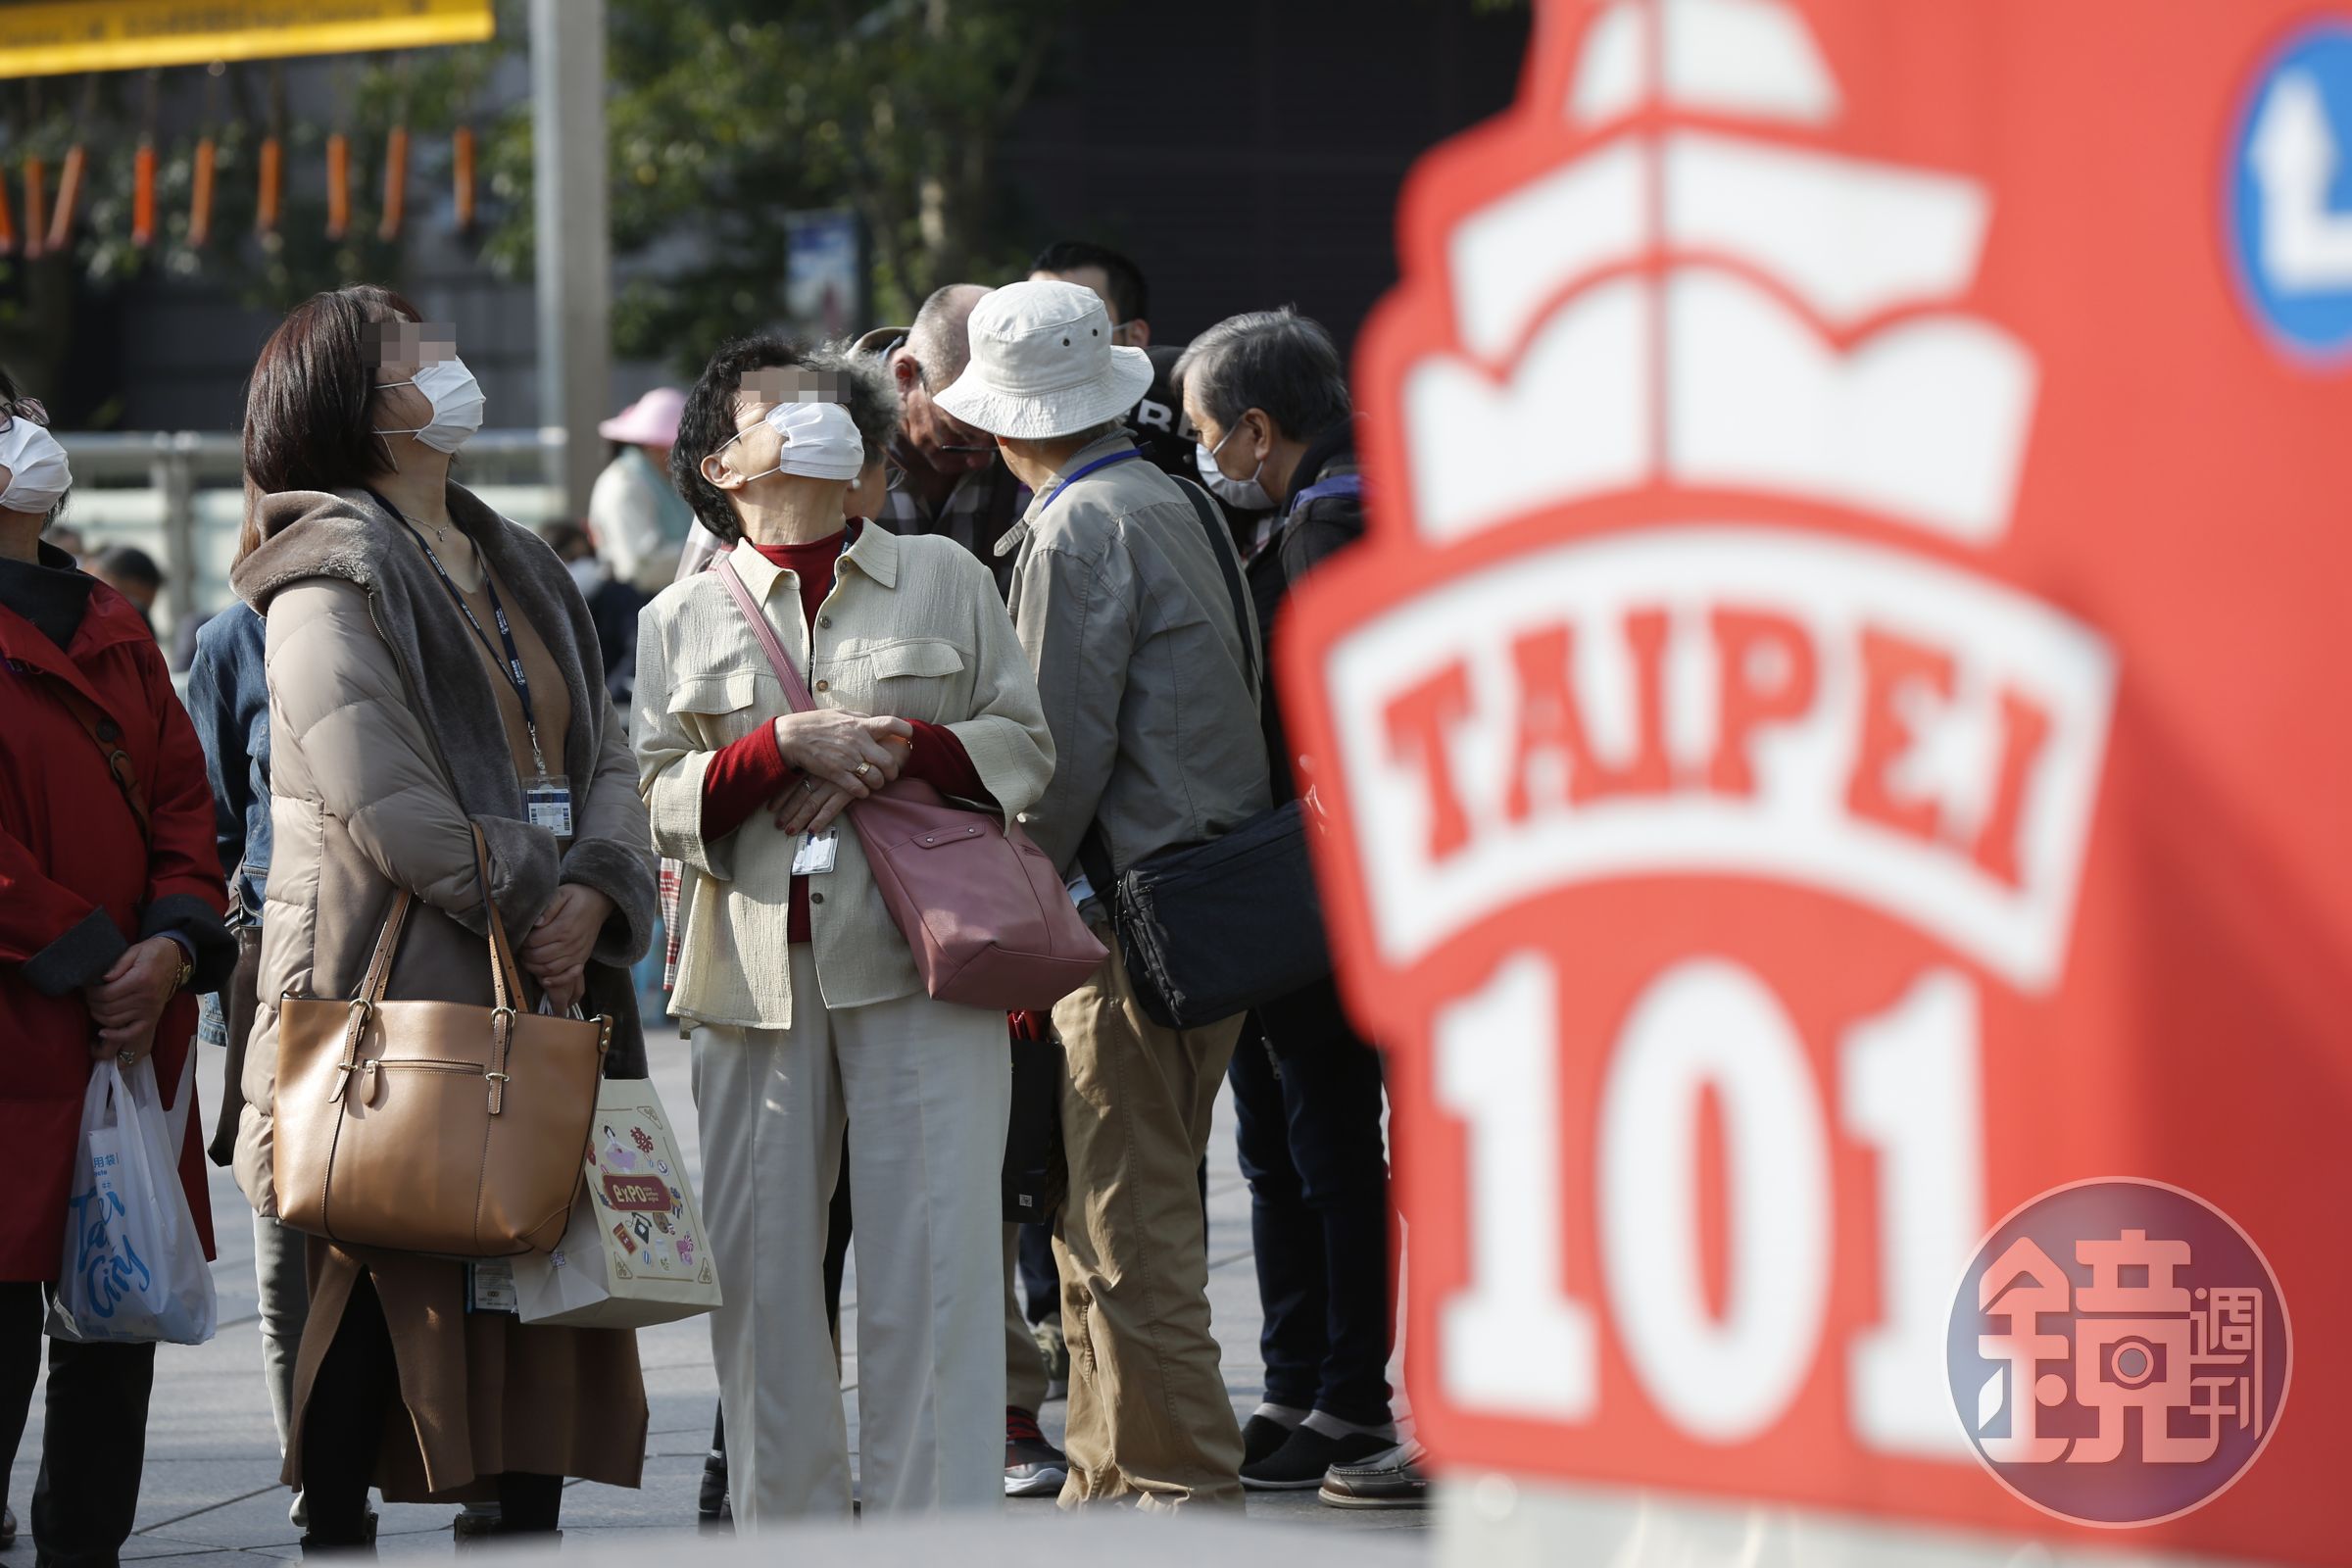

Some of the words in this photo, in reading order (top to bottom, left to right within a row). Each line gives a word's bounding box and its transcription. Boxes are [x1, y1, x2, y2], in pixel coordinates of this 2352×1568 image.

[1378, 602, 2053, 900] TAIPEI
[87, 1234, 150, 1318] City
[1437, 952, 2027, 1456] 101
